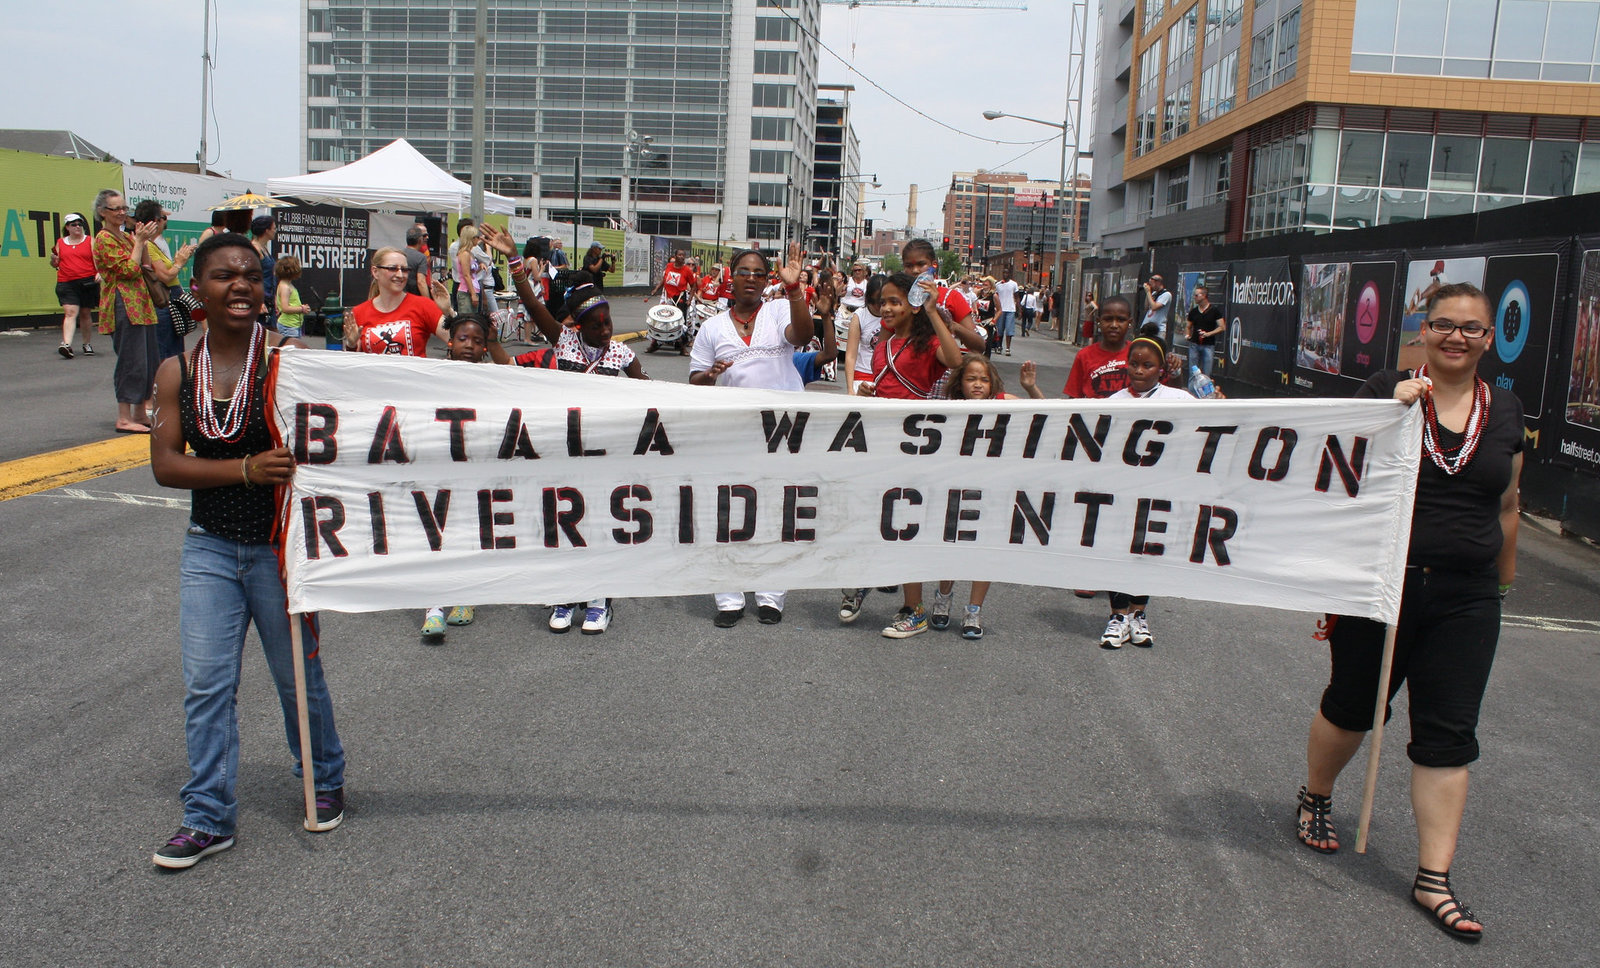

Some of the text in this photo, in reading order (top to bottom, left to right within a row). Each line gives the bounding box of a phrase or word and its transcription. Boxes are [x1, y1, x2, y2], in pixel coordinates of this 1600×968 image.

[128, 178, 187, 196] Looking for some
[278, 212, 283, 221] IF
[302, 214, 315, 225] FANS
[316, 216, 330, 226] WALK
[330, 217, 338, 227] ON
[339, 217, 350, 228] HLF
[278, 233, 290, 242] HOW
[291, 234, 305, 243] MANY
[306, 235, 333, 245] CUSTOMERS
[344, 238, 353, 246] YOU
[1232, 276, 1295, 306] halfstreet.com
[1496, 372, 1514, 391] play
[294, 402, 1369, 498] BATALA WASHINGTON
[300, 484, 1238, 566] RIVERSIDE CENTER
